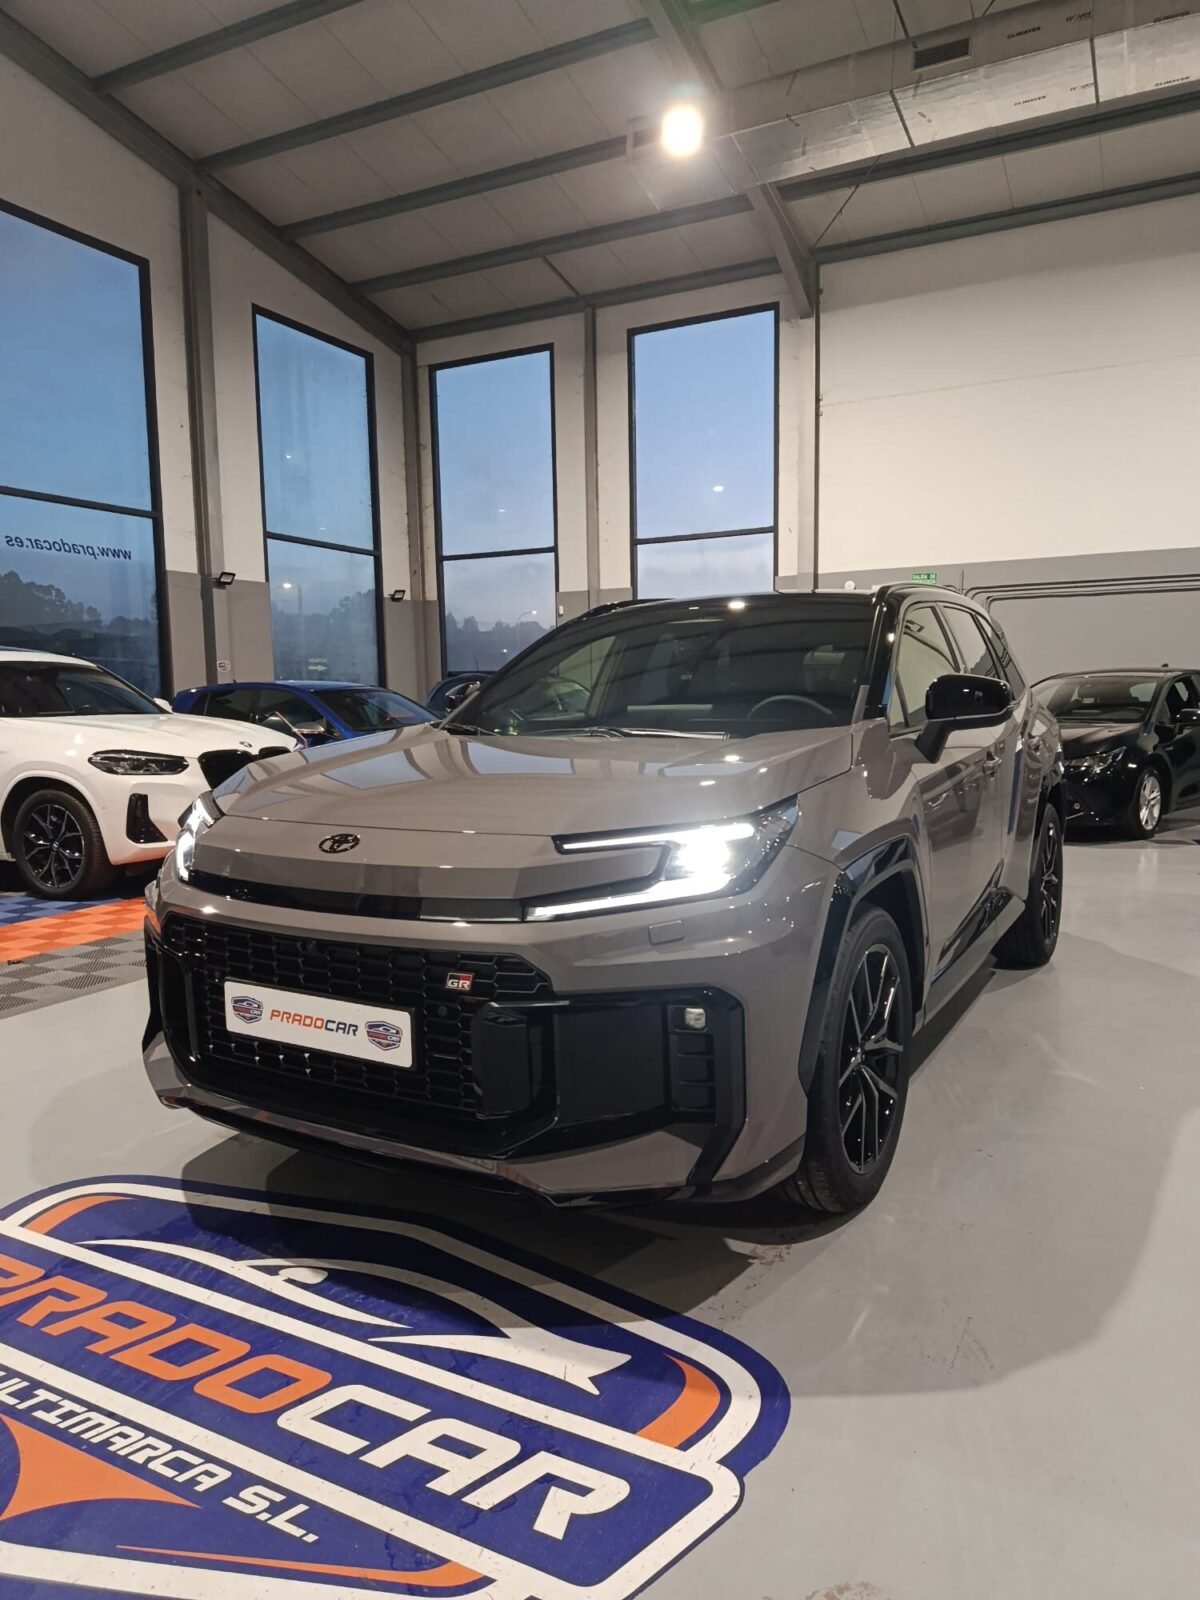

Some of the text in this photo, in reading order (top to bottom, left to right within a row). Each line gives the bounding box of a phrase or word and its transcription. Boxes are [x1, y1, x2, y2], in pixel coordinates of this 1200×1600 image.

[448, 979, 471, 990] GR
[270, 1009, 359, 1037] PRADOCAR
[222, 1485, 319, 1543] S.L.
